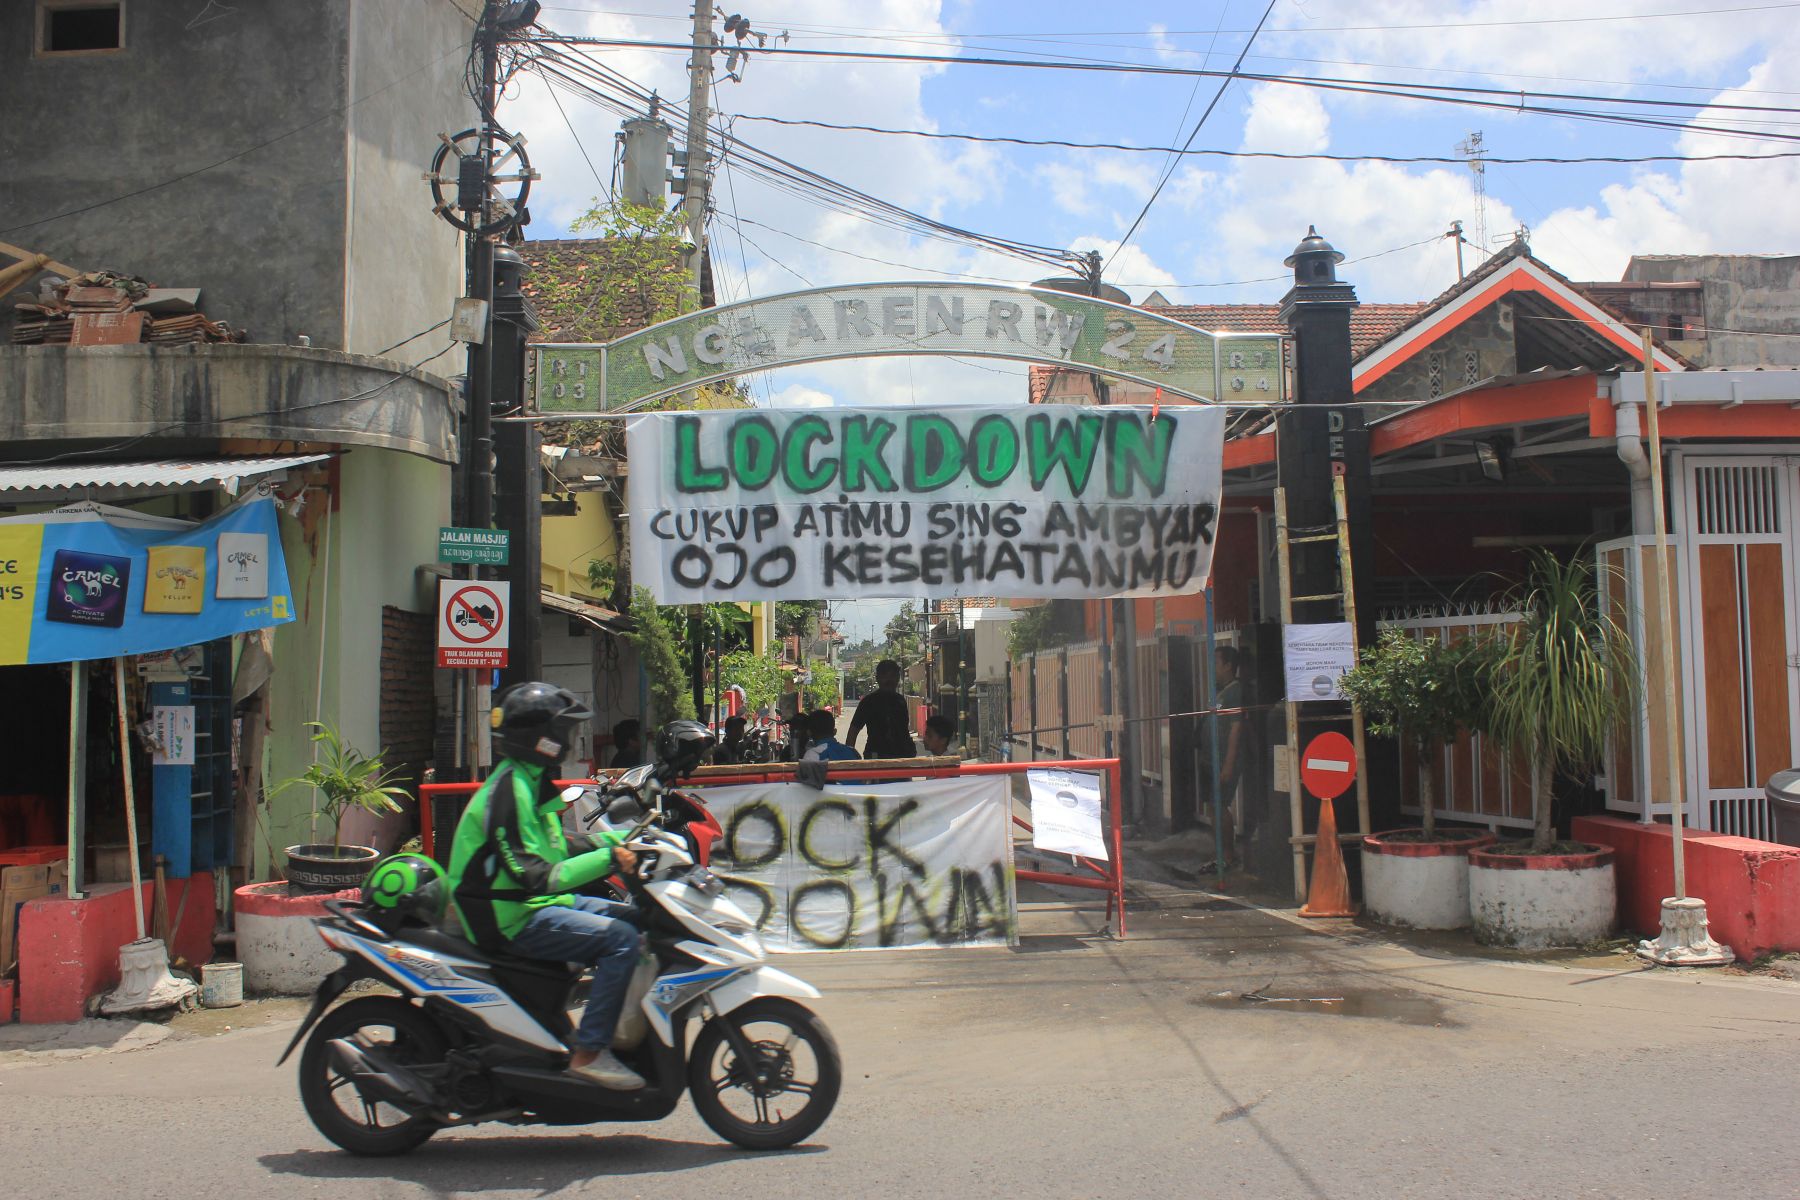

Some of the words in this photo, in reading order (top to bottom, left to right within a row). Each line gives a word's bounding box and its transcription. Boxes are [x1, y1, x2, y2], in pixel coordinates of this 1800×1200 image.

[1100, 319, 1176, 371] 24
[552, 359, 589, 377] RT
[552, 383, 586, 399] 03
[675, 413, 1177, 498] LOCKDOWN
[1043, 501, 1213, 551] AMBYAR
[441, 532, 471, 542] JALAN
[473, 533, 507, 544] MASJID
[227, 552, 258, 564] CAMEL
[671, 543, 796, 590] OJO
[823, 539, 1199, 590] KESEHATANMU
[62, 570, 121, 588] CAMEL
[156, 567, 199, 581] CAMEL
[72, 609, 105, 618] ACTIVATE
[712, 795, 926, 879] OCK
